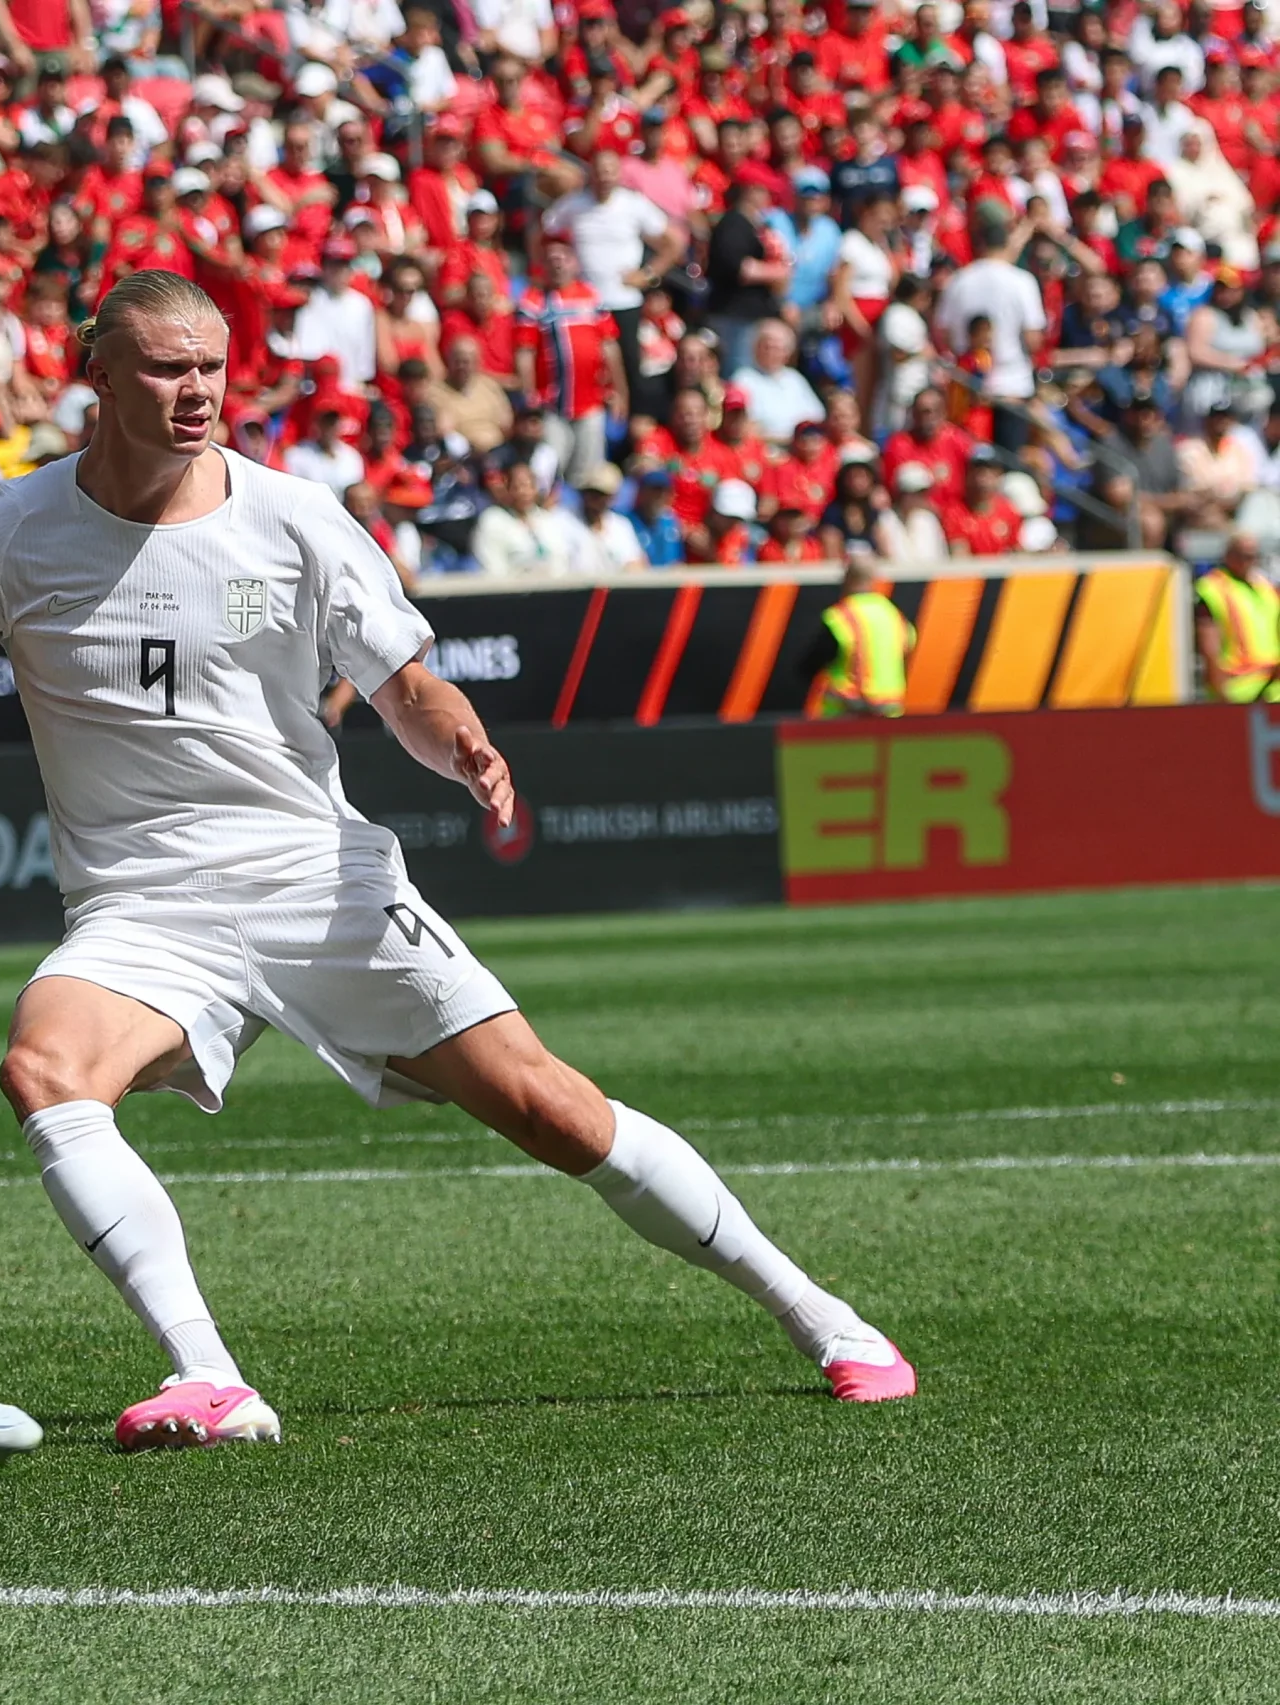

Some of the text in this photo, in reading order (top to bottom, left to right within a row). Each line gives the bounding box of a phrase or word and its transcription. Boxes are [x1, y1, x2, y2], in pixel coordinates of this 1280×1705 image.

[140, 637, 176, 716] 9
[540, 804, 658, 843] TURKISH
[660, 797, 779, 838] AIRLINES
[778, 733, 1012, 873] ER
[383, 902, 455, 959] 9
